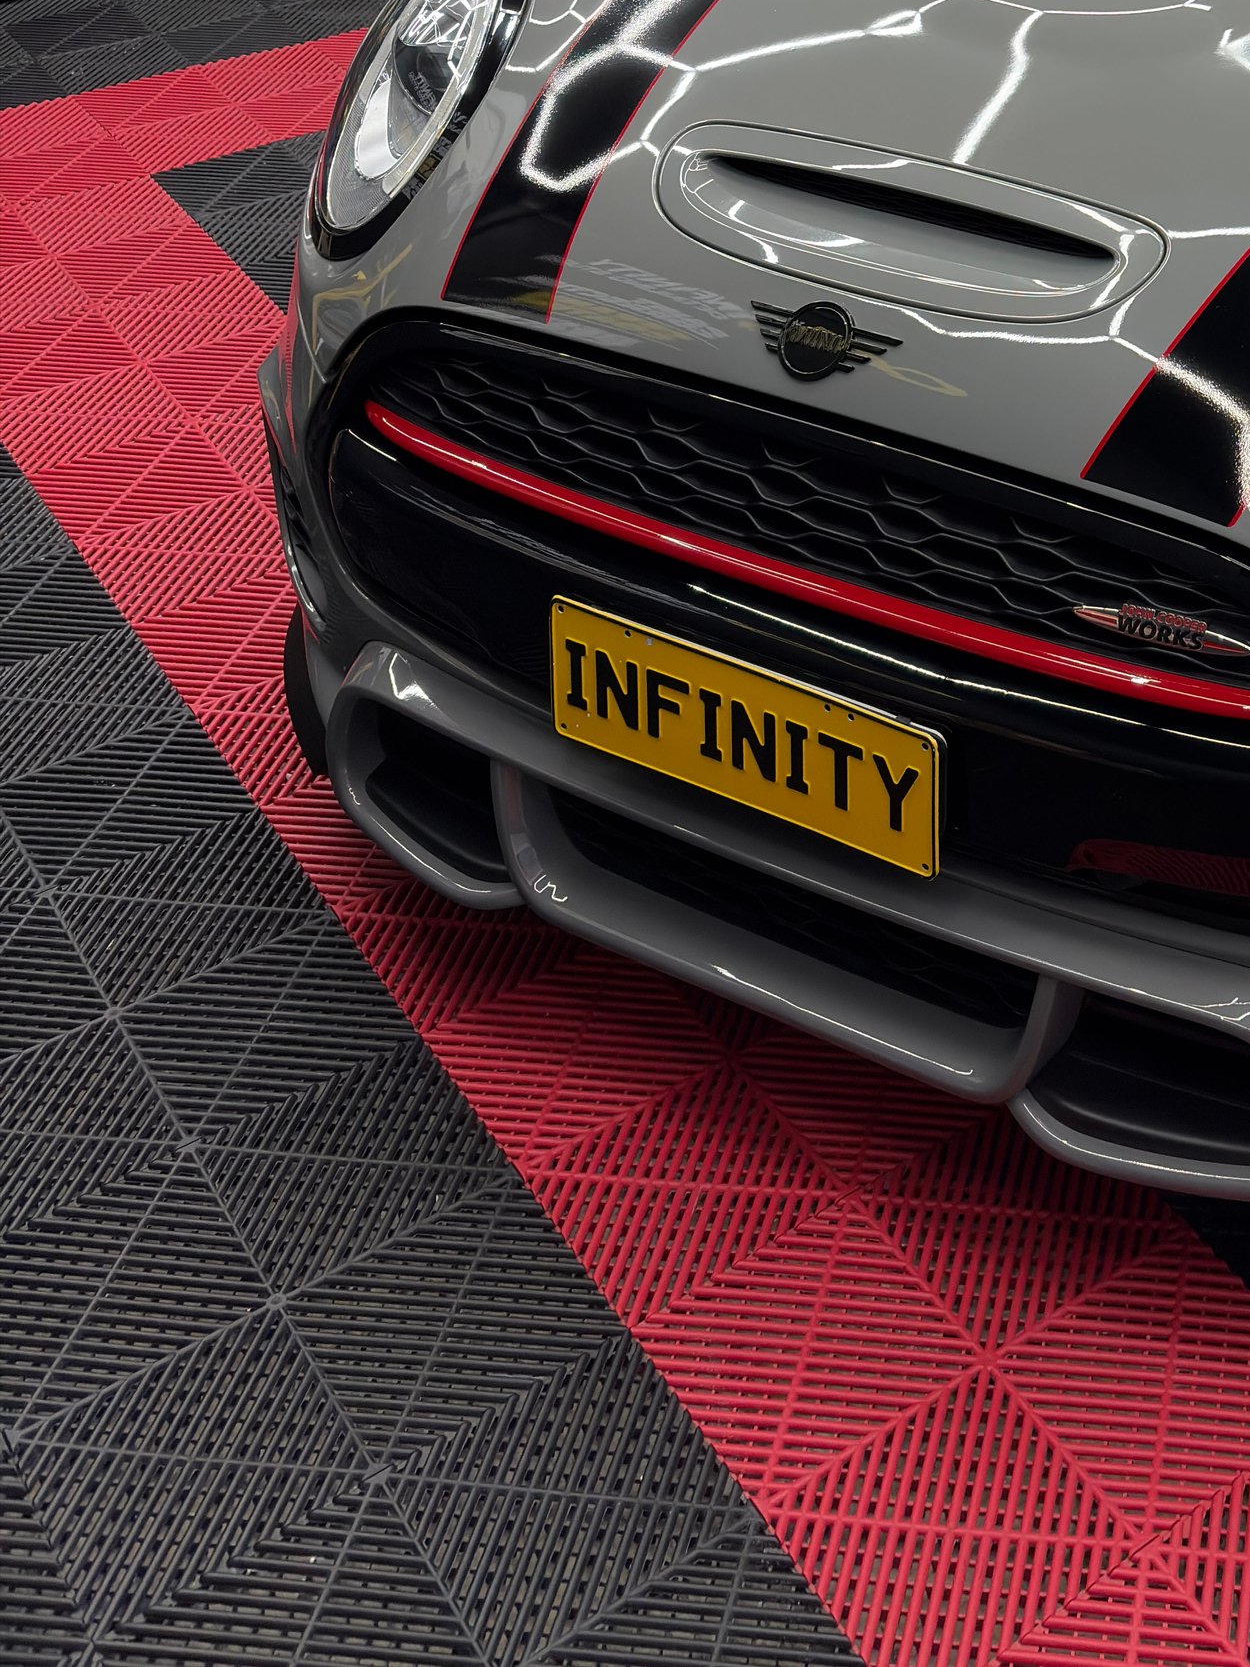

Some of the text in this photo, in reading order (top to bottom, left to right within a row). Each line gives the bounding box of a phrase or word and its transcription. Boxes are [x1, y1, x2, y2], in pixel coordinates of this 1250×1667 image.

[1117, 613, 1204, 651] WORKS
[1120, 603, 1208, 633] JOHN COOPER
[565, 638, 920, 833] INFINITY
